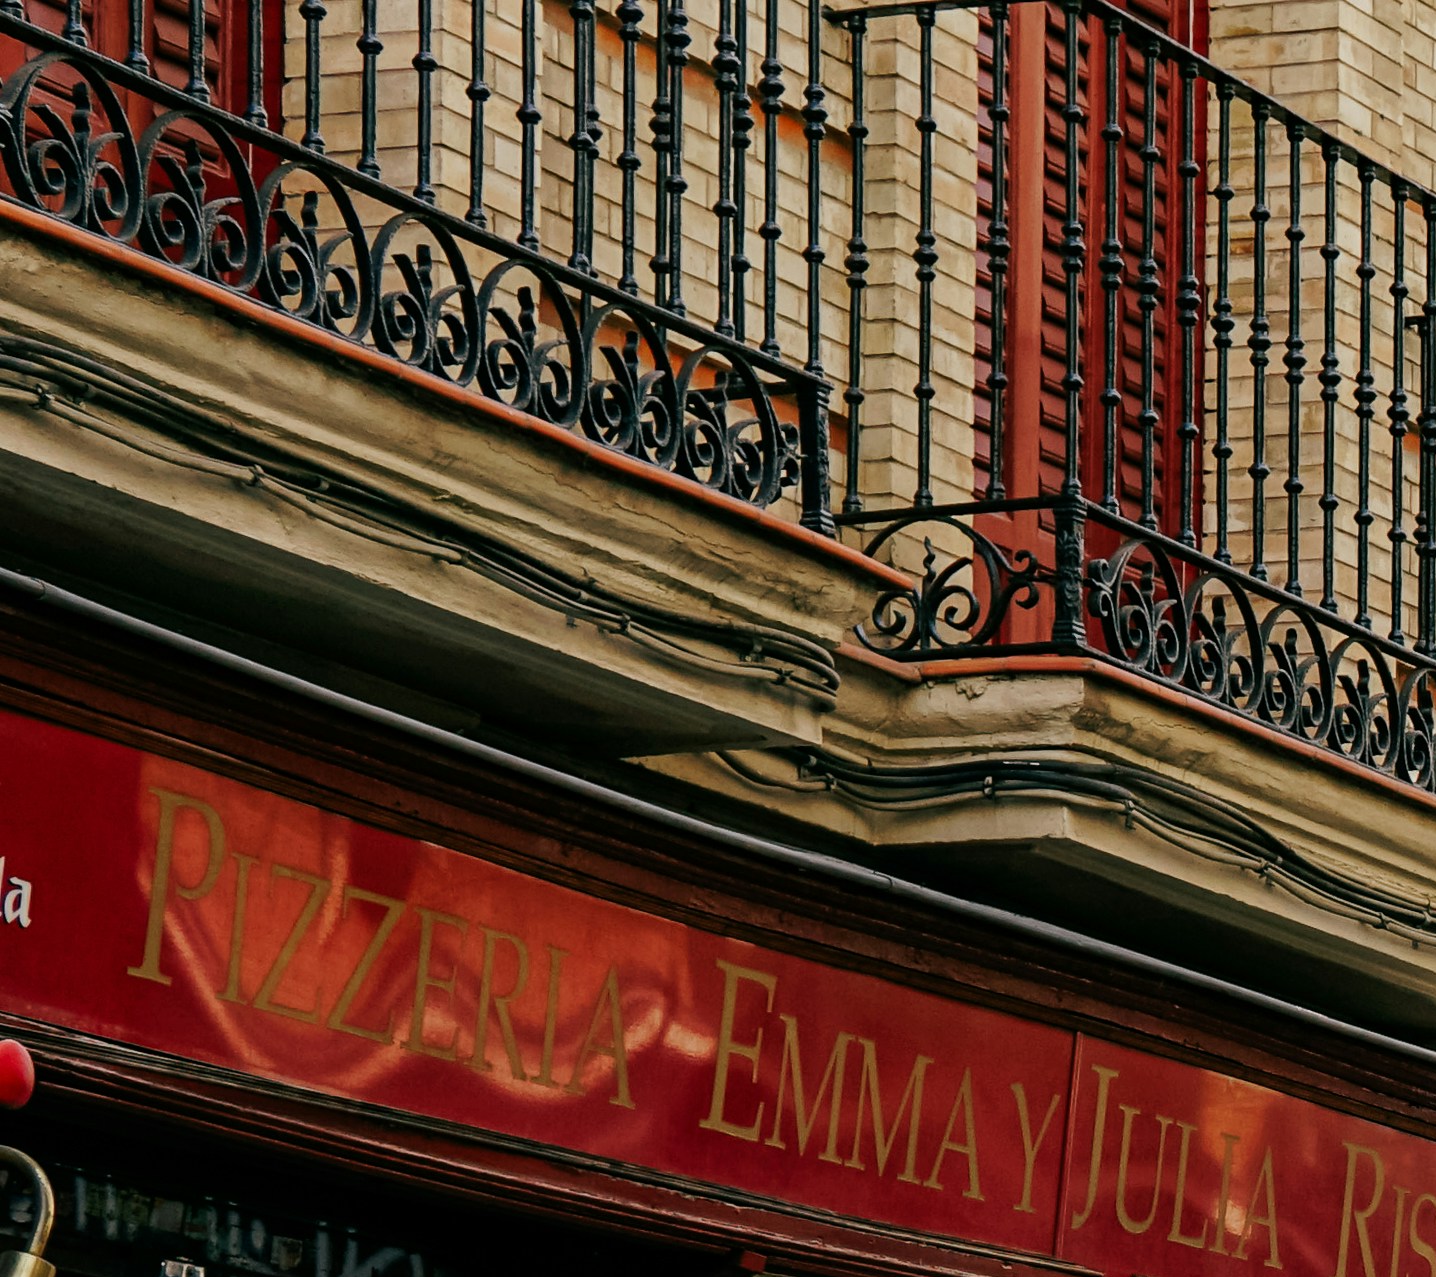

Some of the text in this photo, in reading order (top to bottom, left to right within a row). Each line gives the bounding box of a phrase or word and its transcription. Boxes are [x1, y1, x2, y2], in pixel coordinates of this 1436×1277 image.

[127, 786, 637, 1109] PIZZERIA
[698, 958, 986, 1202] EMMA
[1011, 1080, 1061, 1215] Y
[1071, 1064, 1283, 1271] JULIA
